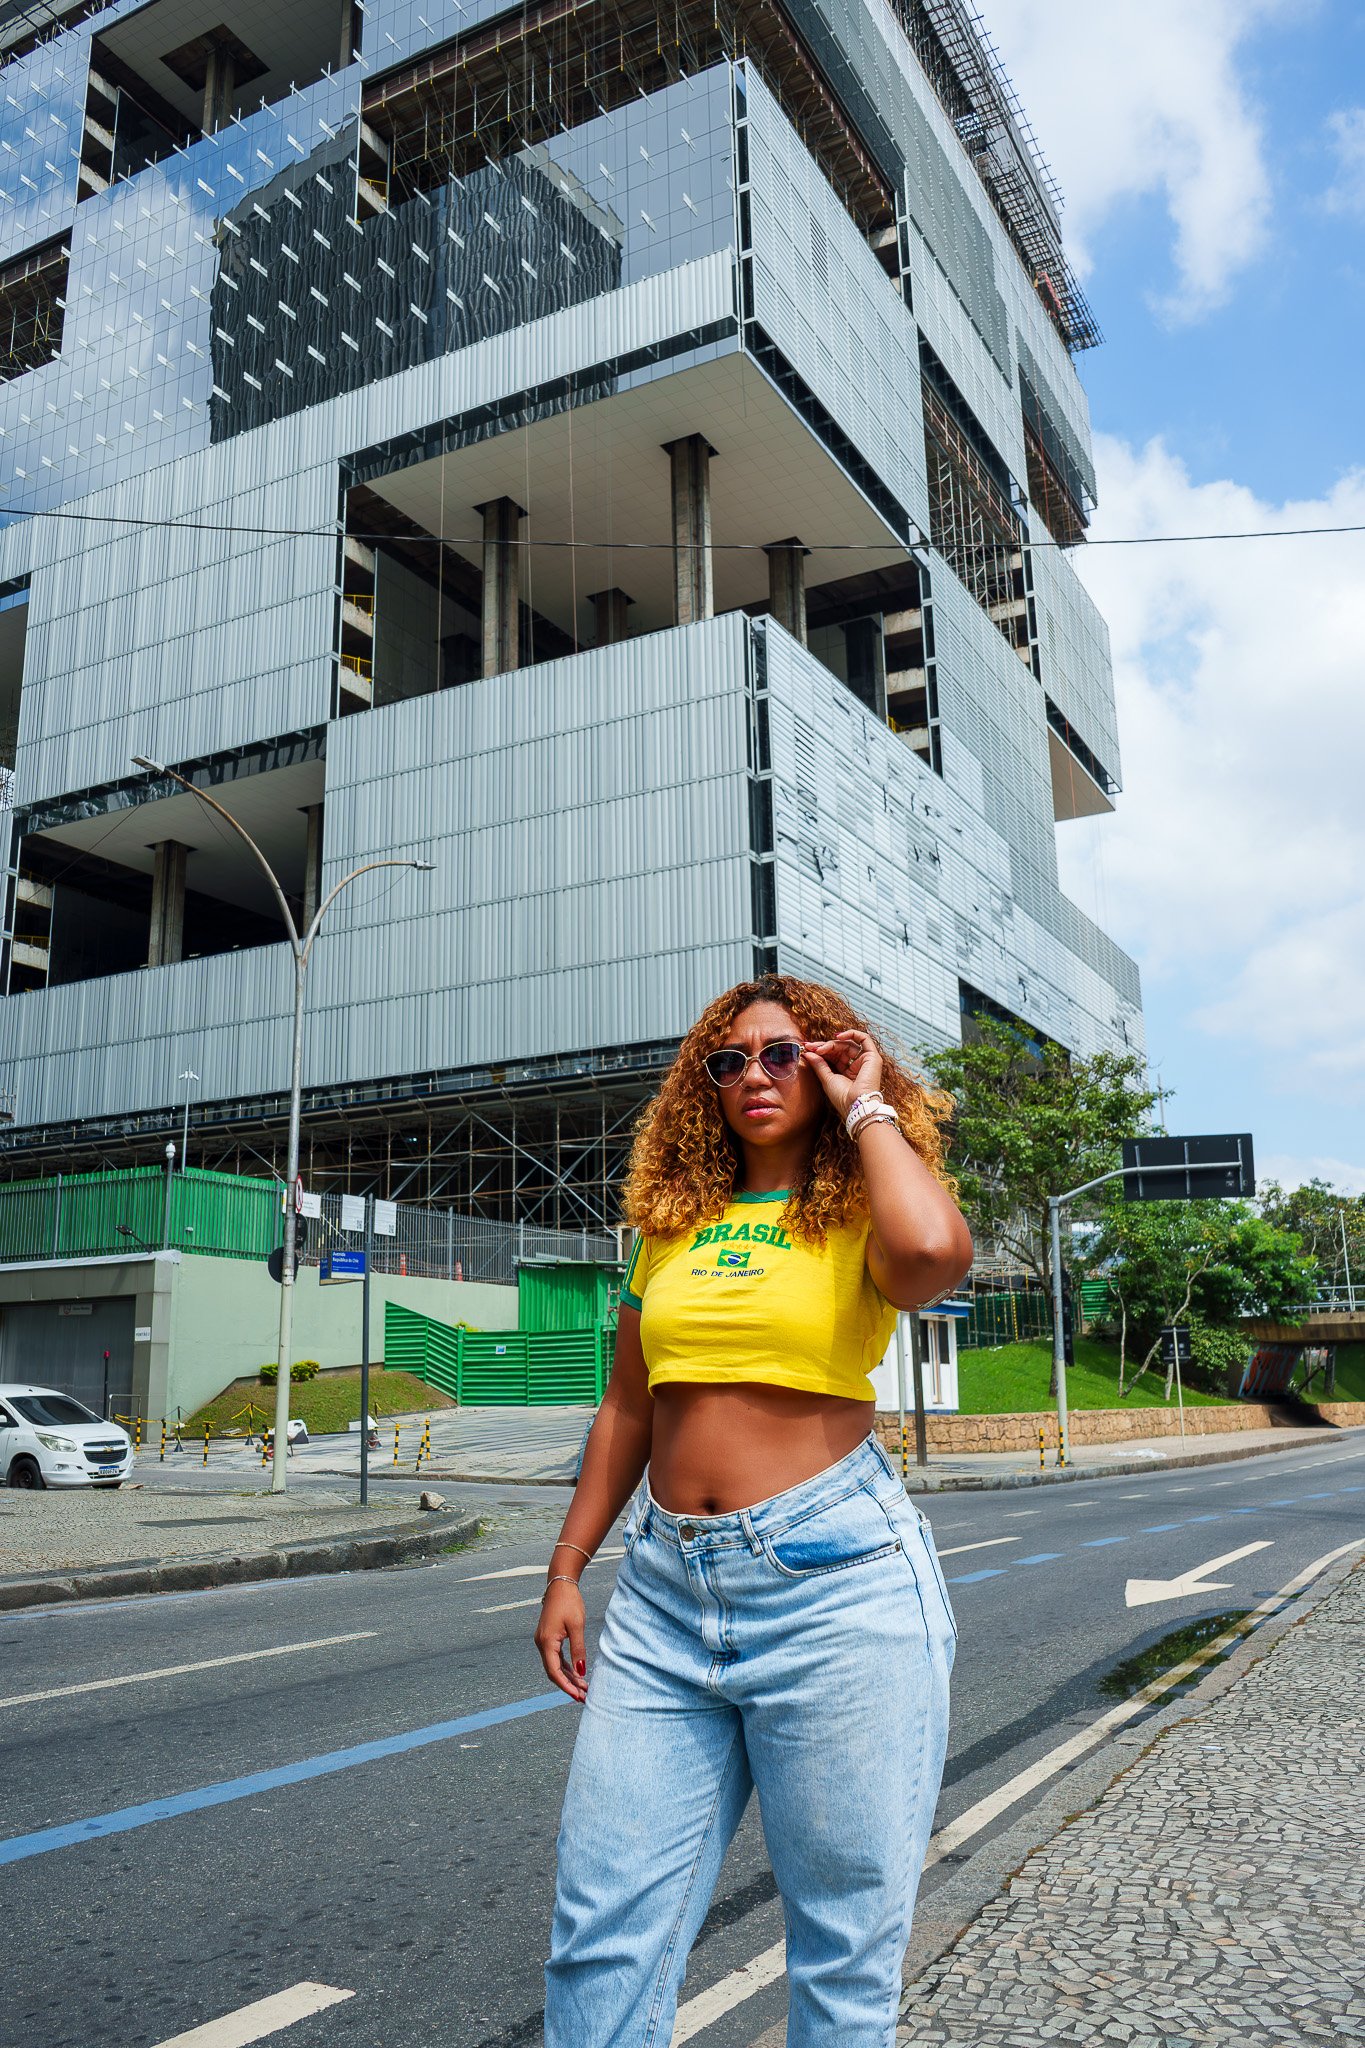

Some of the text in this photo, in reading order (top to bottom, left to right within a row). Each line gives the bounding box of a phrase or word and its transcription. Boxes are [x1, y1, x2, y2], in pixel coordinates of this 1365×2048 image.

[689, 1223, 791, 1252] BRASIL
[691, 1268, 707, 1276] RIO
[725, 1268, 765, 1278] JANEIRO
